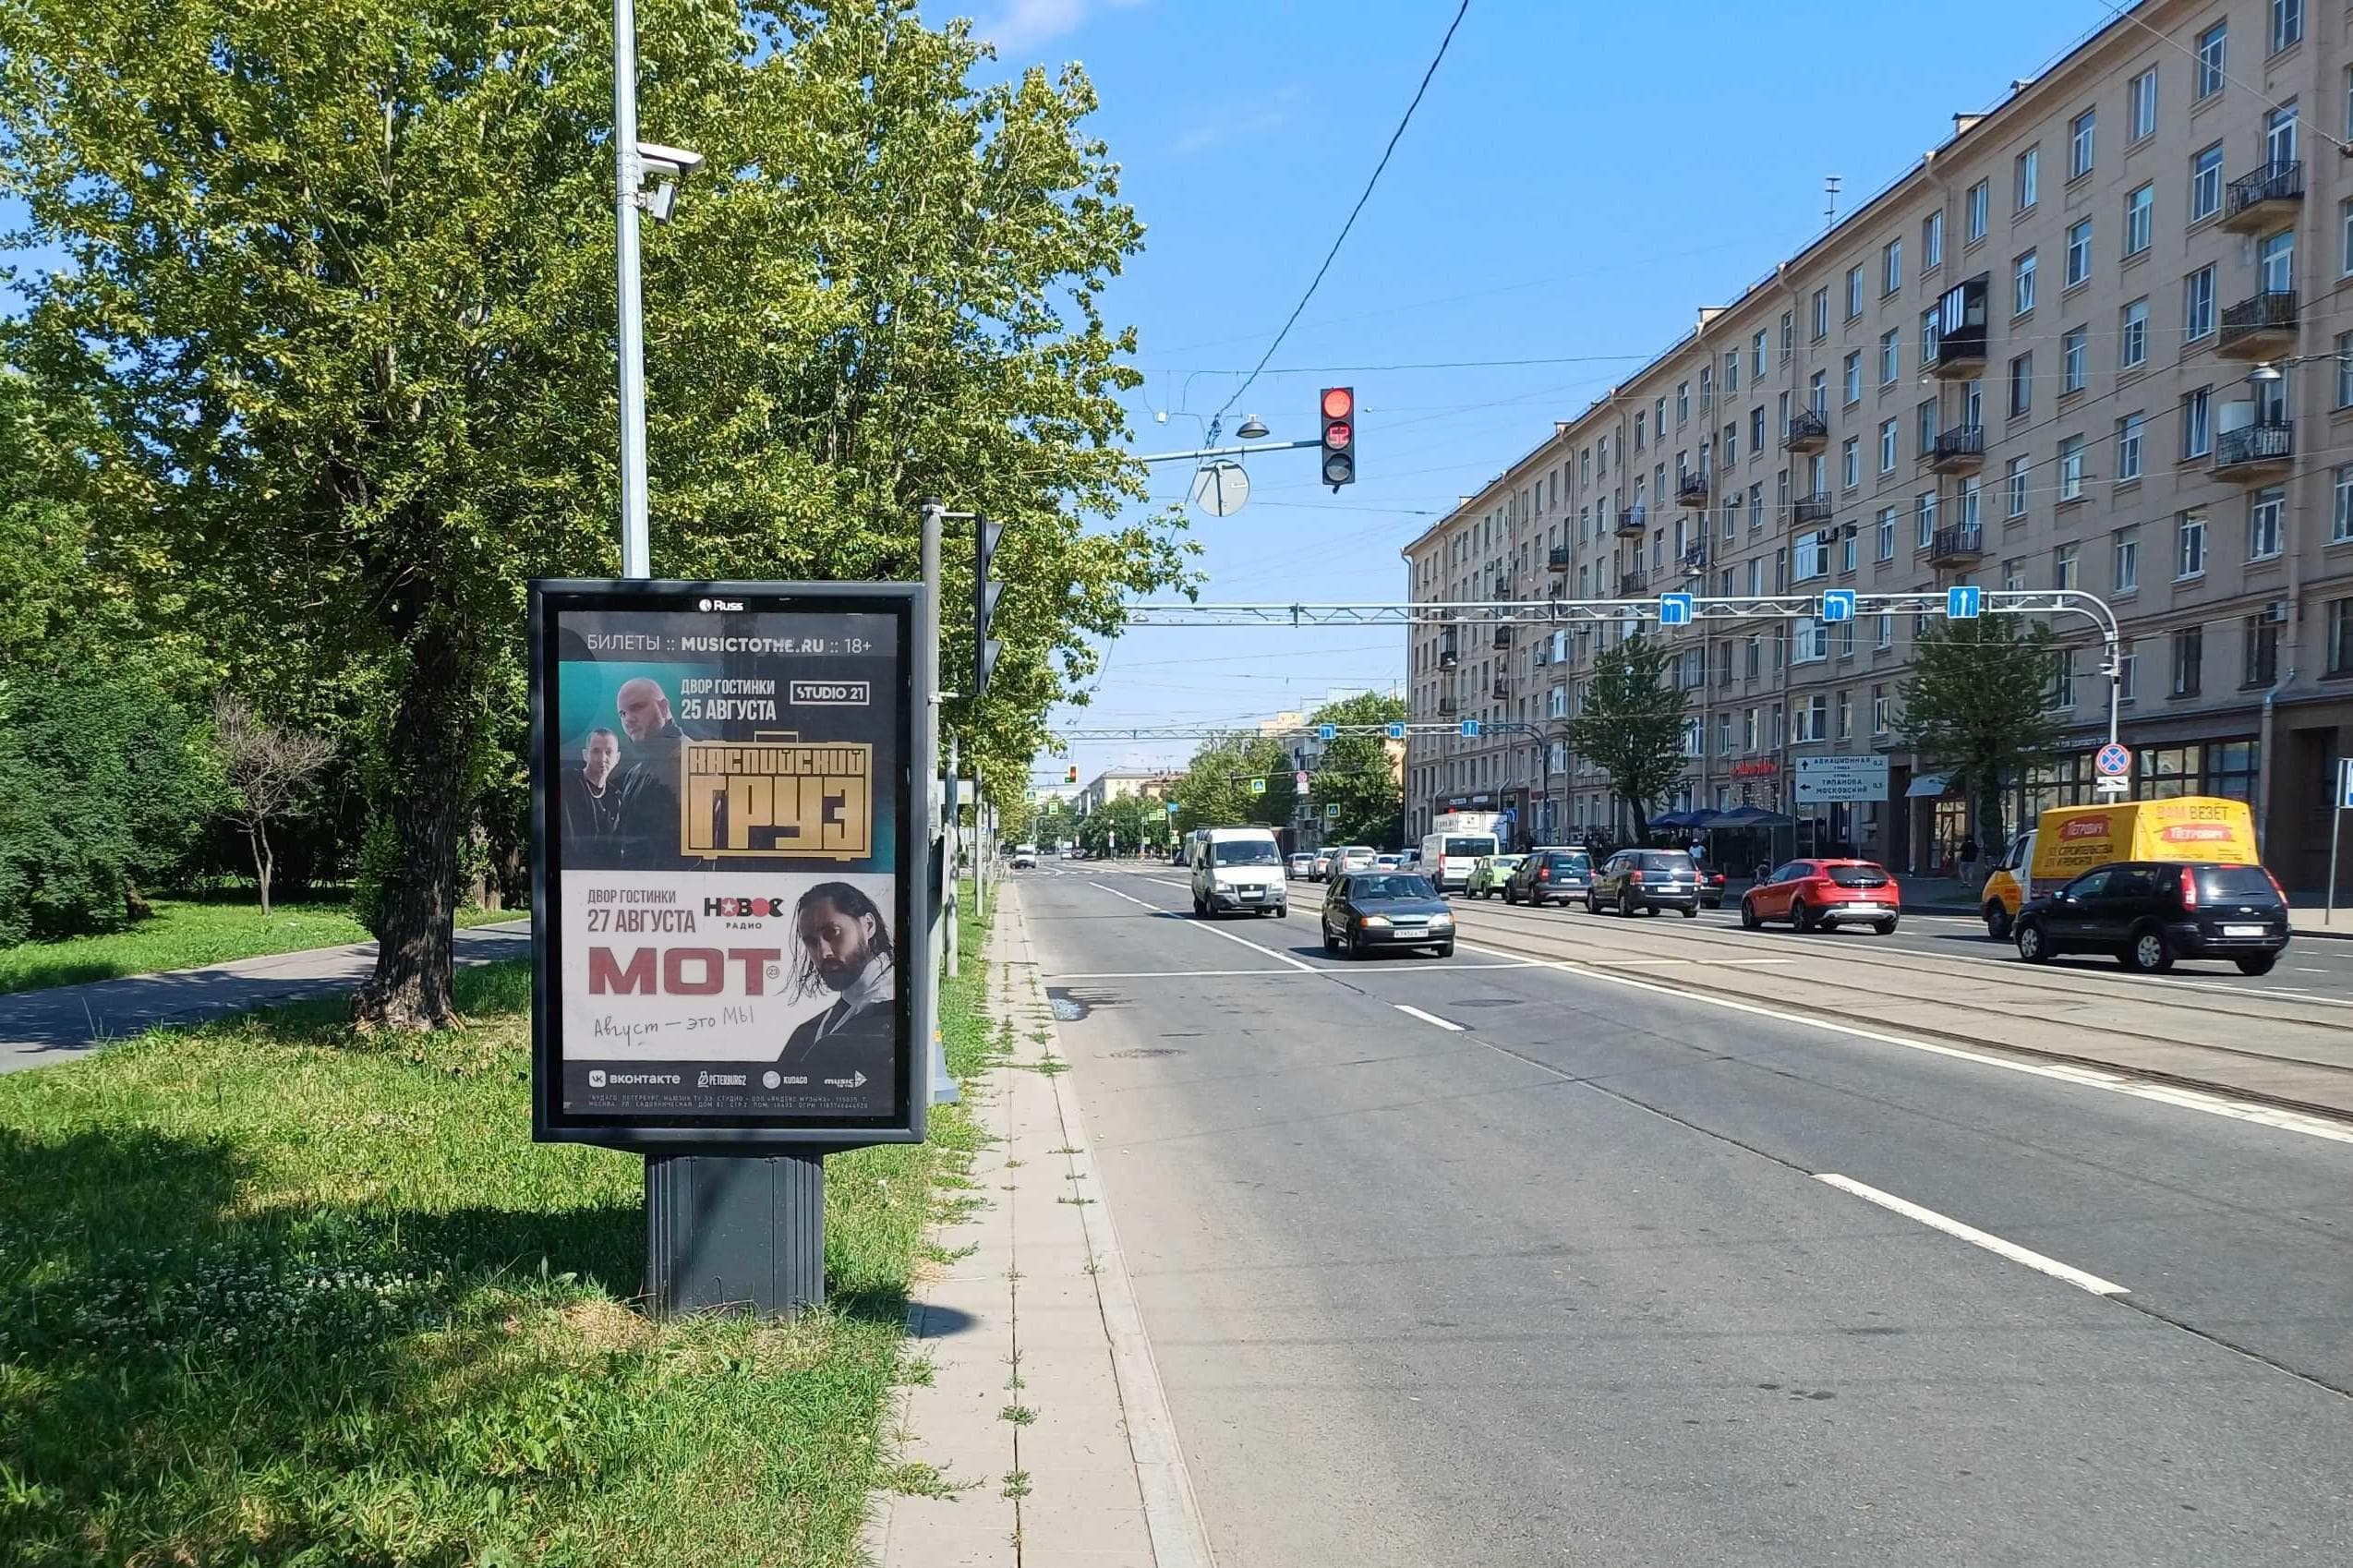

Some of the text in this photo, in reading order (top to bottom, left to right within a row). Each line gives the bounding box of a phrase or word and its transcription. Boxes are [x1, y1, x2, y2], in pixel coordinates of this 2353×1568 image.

[713, 599, 744, 611] Russ
[587, 634, 660, 650] БИЛЕТЫ
[681, 636, 825, 653] MUSICTOTHE.RU
[844, 638, 873, 654] 18+
[681, 679, 776, 695] ДВОР ГОСТИНКИ
[796, 687, 864, 700] STUDIO 21
[681, 699, 777, 720] 25 АВГУСТА
[690, 749, 864, 775] КАСПИЙСКИЙ
[1816, 786, 1868, 794] МОСКОВСКИЙ
[689, 775, 864, 850] ГРУЗ
[587, 889, 676, 904] ДВОР ГОСТИНКИ
[587, 909, 696, 933] 27 АВГУСТА
[589, 947, 781, 996] МОТ
[595, 1016, 658, 1047] Август
[687, 1018, 716, 1030] это
[723, 1005, 754, 1025] МЫ
[783, 1076, 808, 1085] KUDAGO
